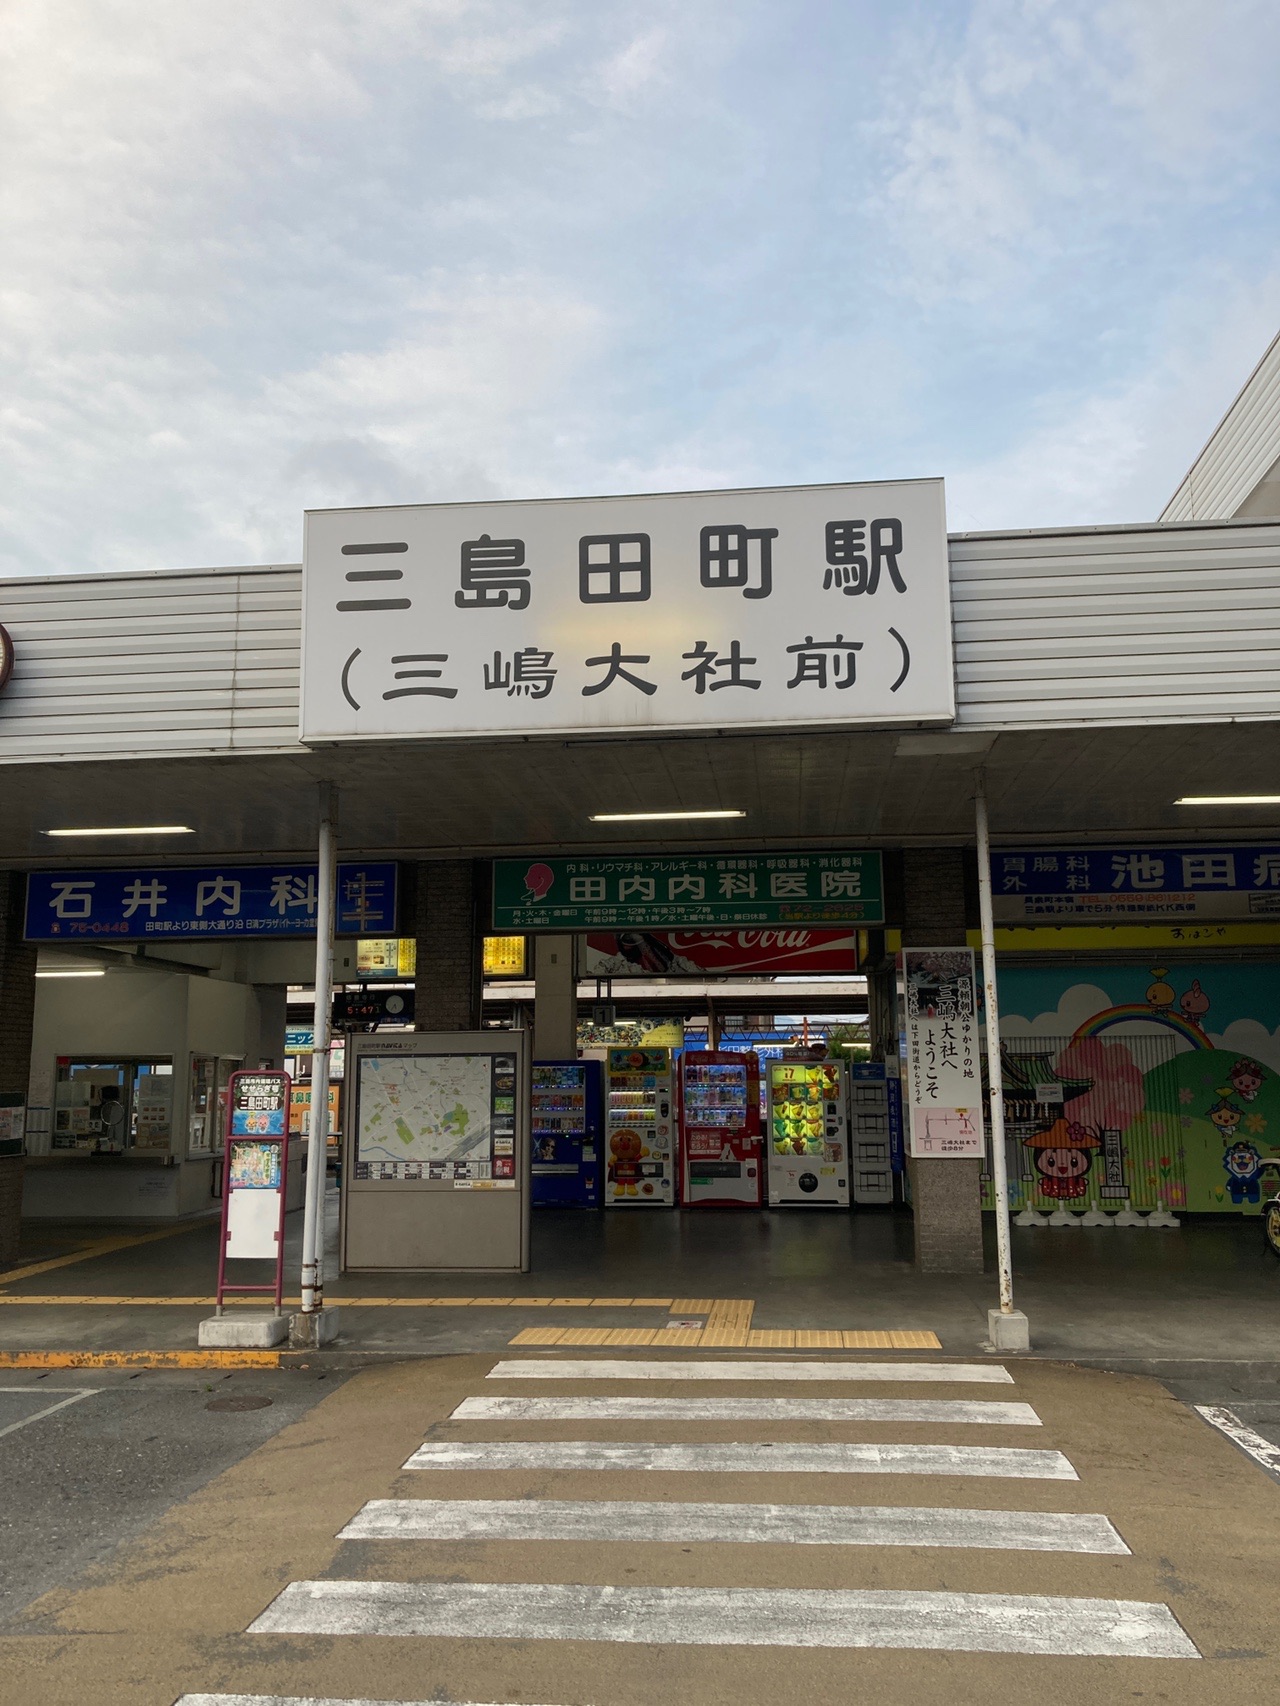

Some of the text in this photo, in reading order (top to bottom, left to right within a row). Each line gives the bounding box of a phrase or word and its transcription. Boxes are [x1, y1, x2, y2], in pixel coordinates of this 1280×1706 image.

[336, 516, 907, 612] 三島田町駅
[341, 626, 911, 711] (三嶋大社前)
[1003, 855, 1090, 873] 胃腸科
[1003, 875, 1091, 892] 外科
[49, 874, 318, 919] 石井内科
[569, 869, 861, 902] 田内内科医院
[1079, 895, 1105, 904] TEL
[347, 1006, 373, 1015] 5:47
[936, 985, 958, 1070] 三嶋大社へ
[959, 978, 975, 1079] 源頼朝公ゆかりの地
[925, 1029, 939, 1099] ようこそ
[239, 1096, 279, 1110] 三島田町駅
